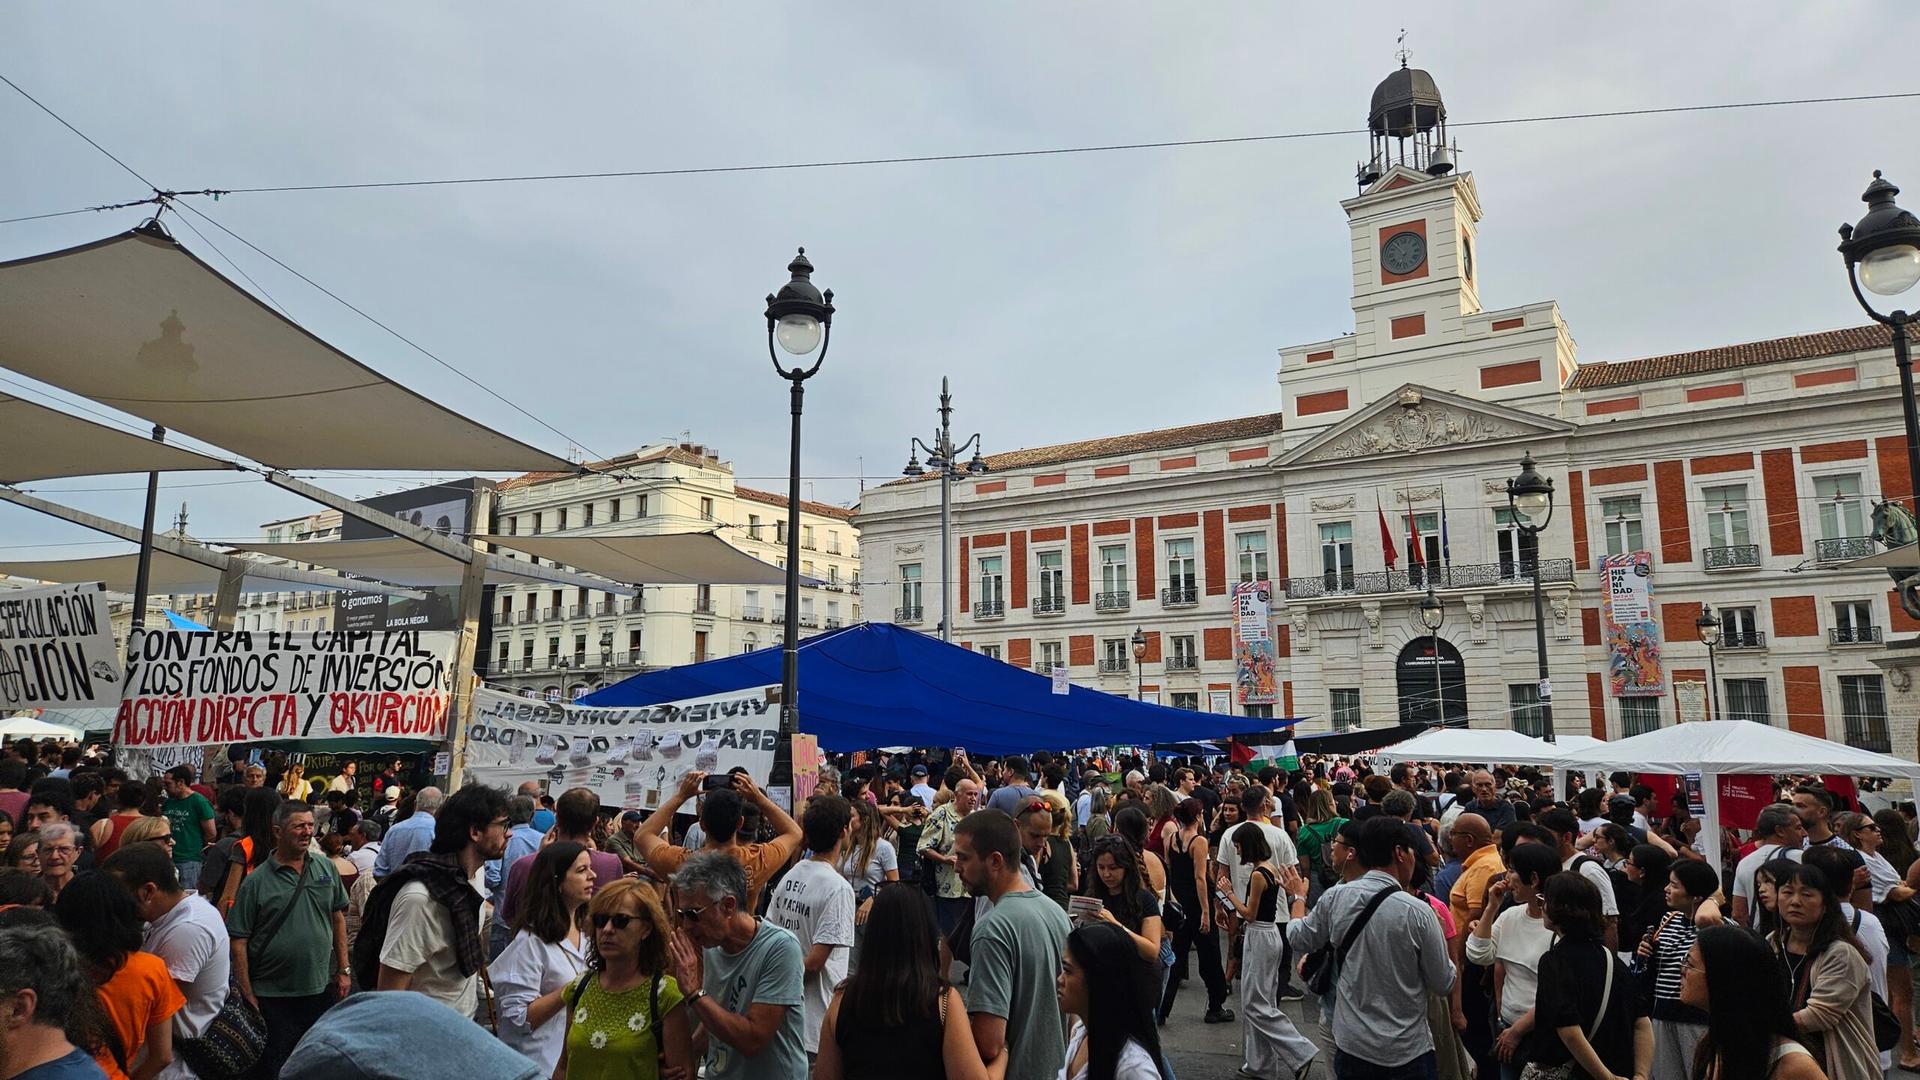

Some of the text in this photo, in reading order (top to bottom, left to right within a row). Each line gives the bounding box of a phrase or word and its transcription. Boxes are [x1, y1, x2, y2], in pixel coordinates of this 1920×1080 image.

[0, 584, 98, 639] SPEKULACIÓN
[341, 594, 383, 610] o ganamos
[386, 615, 429, 627] LA BOLA NEGRA
[126, 628, 431, 662] CONTRA EL CAPITAL
[121, 653, 454, 699] Y LOS FONDOS DE INVERSIÓN
[111, 689, 450, 746] ACCIÓN DIRECTA Y OKUPACIÓN
